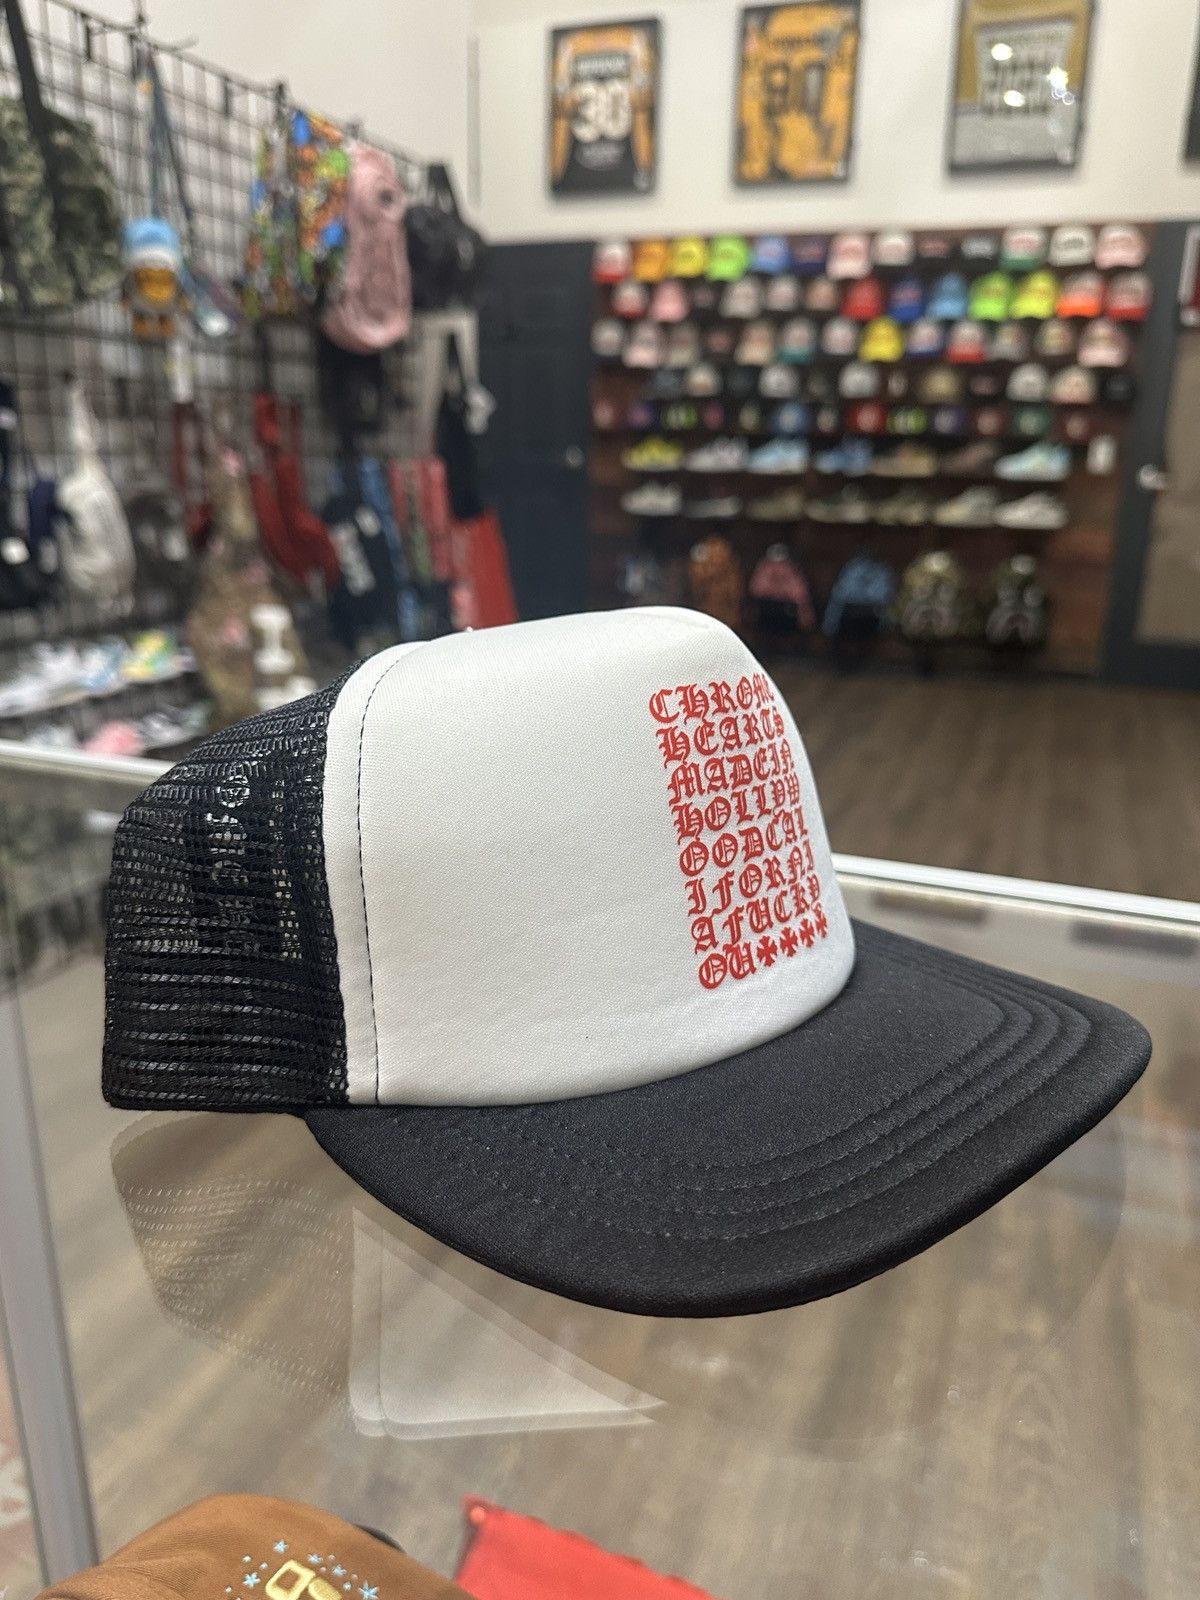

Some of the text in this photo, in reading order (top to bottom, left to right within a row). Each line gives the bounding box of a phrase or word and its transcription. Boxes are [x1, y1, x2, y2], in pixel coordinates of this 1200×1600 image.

[656, 705, 785, 769] HEARTS
[667, 739, 795, 806] MADEIN
[671, 772, 800, 846] HOLLYW
[679, 805, 808, 877] OODCAL
[685, 840, 815, 917] IFORNI
[691, 873, 822, 955] AFUCKY
